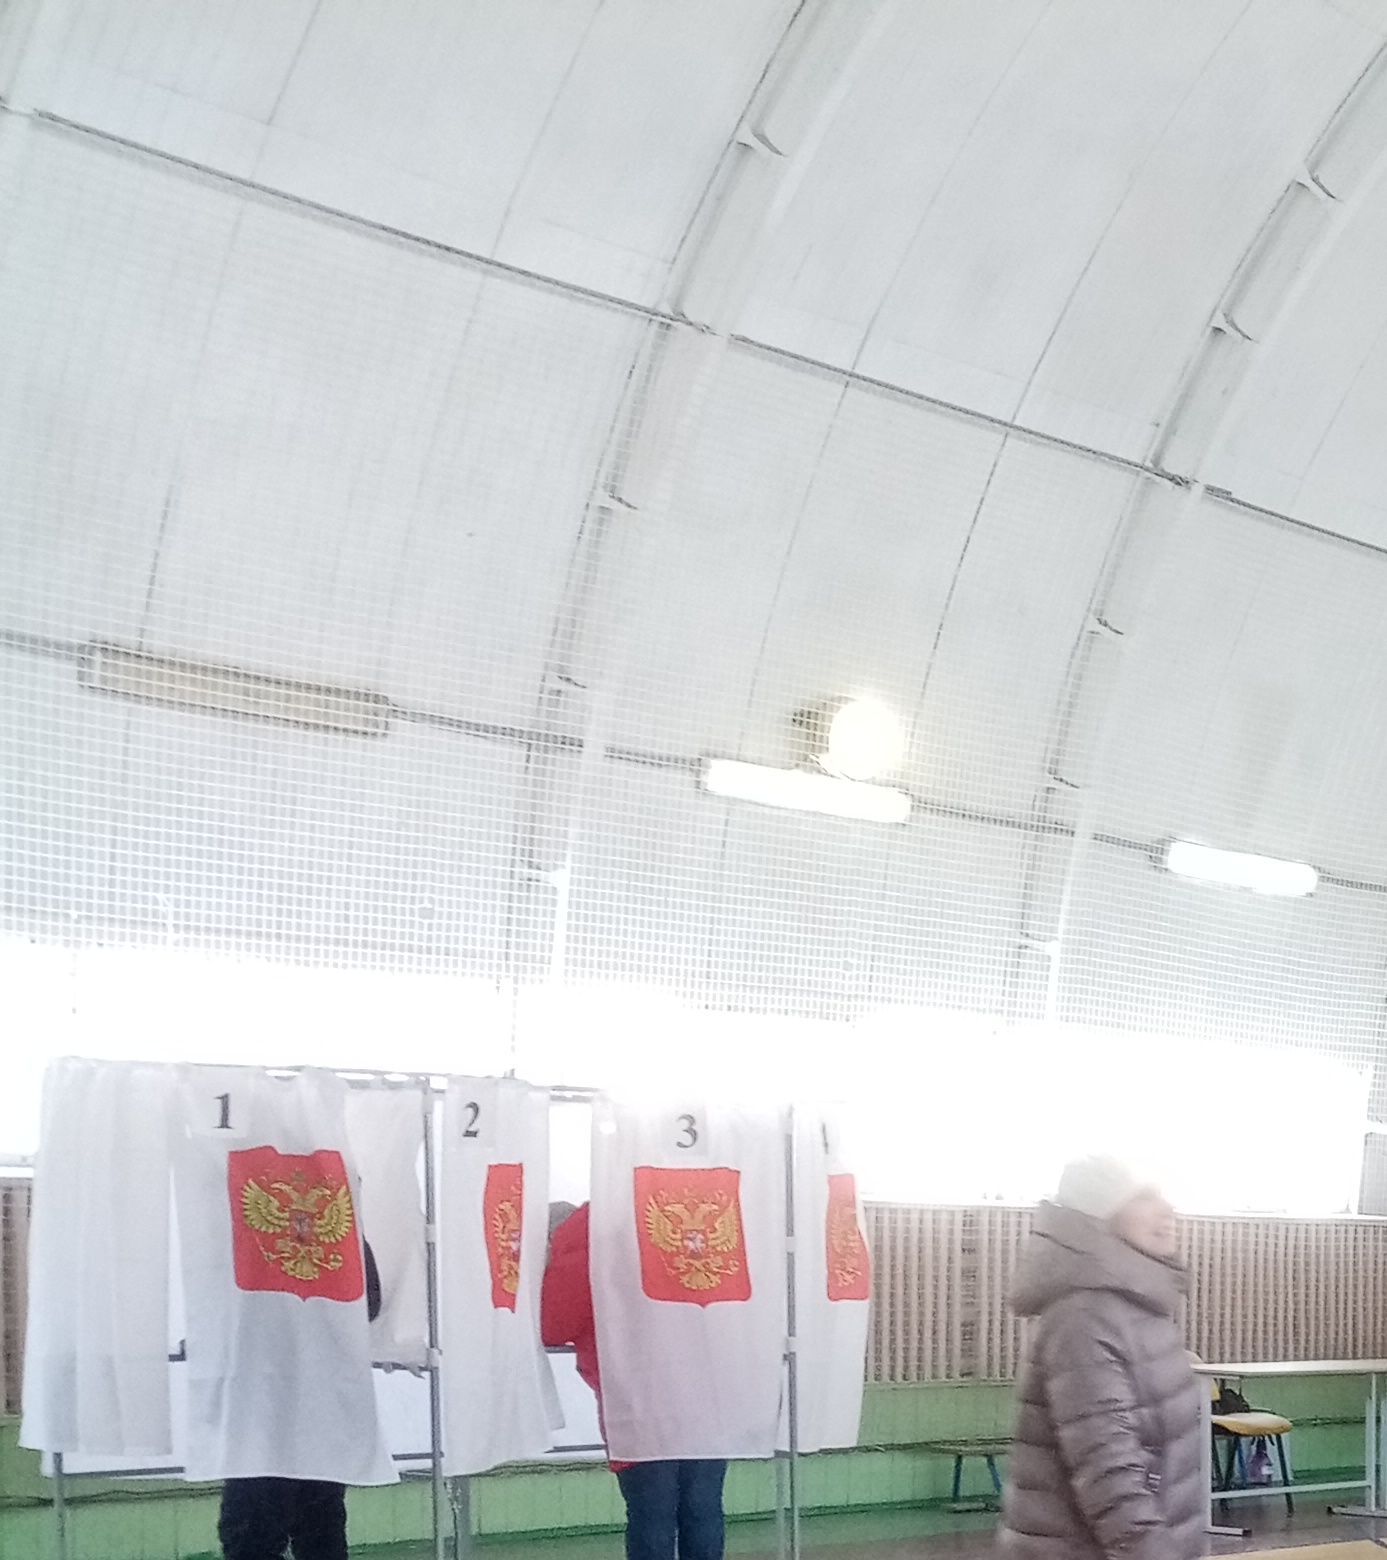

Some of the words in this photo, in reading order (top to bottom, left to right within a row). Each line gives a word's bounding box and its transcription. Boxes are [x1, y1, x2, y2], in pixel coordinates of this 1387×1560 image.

[213, 1092, 233, 1130] 1
[462, 1101, 481, 1138] 2
[675, 1114, 699, 1149] 3
